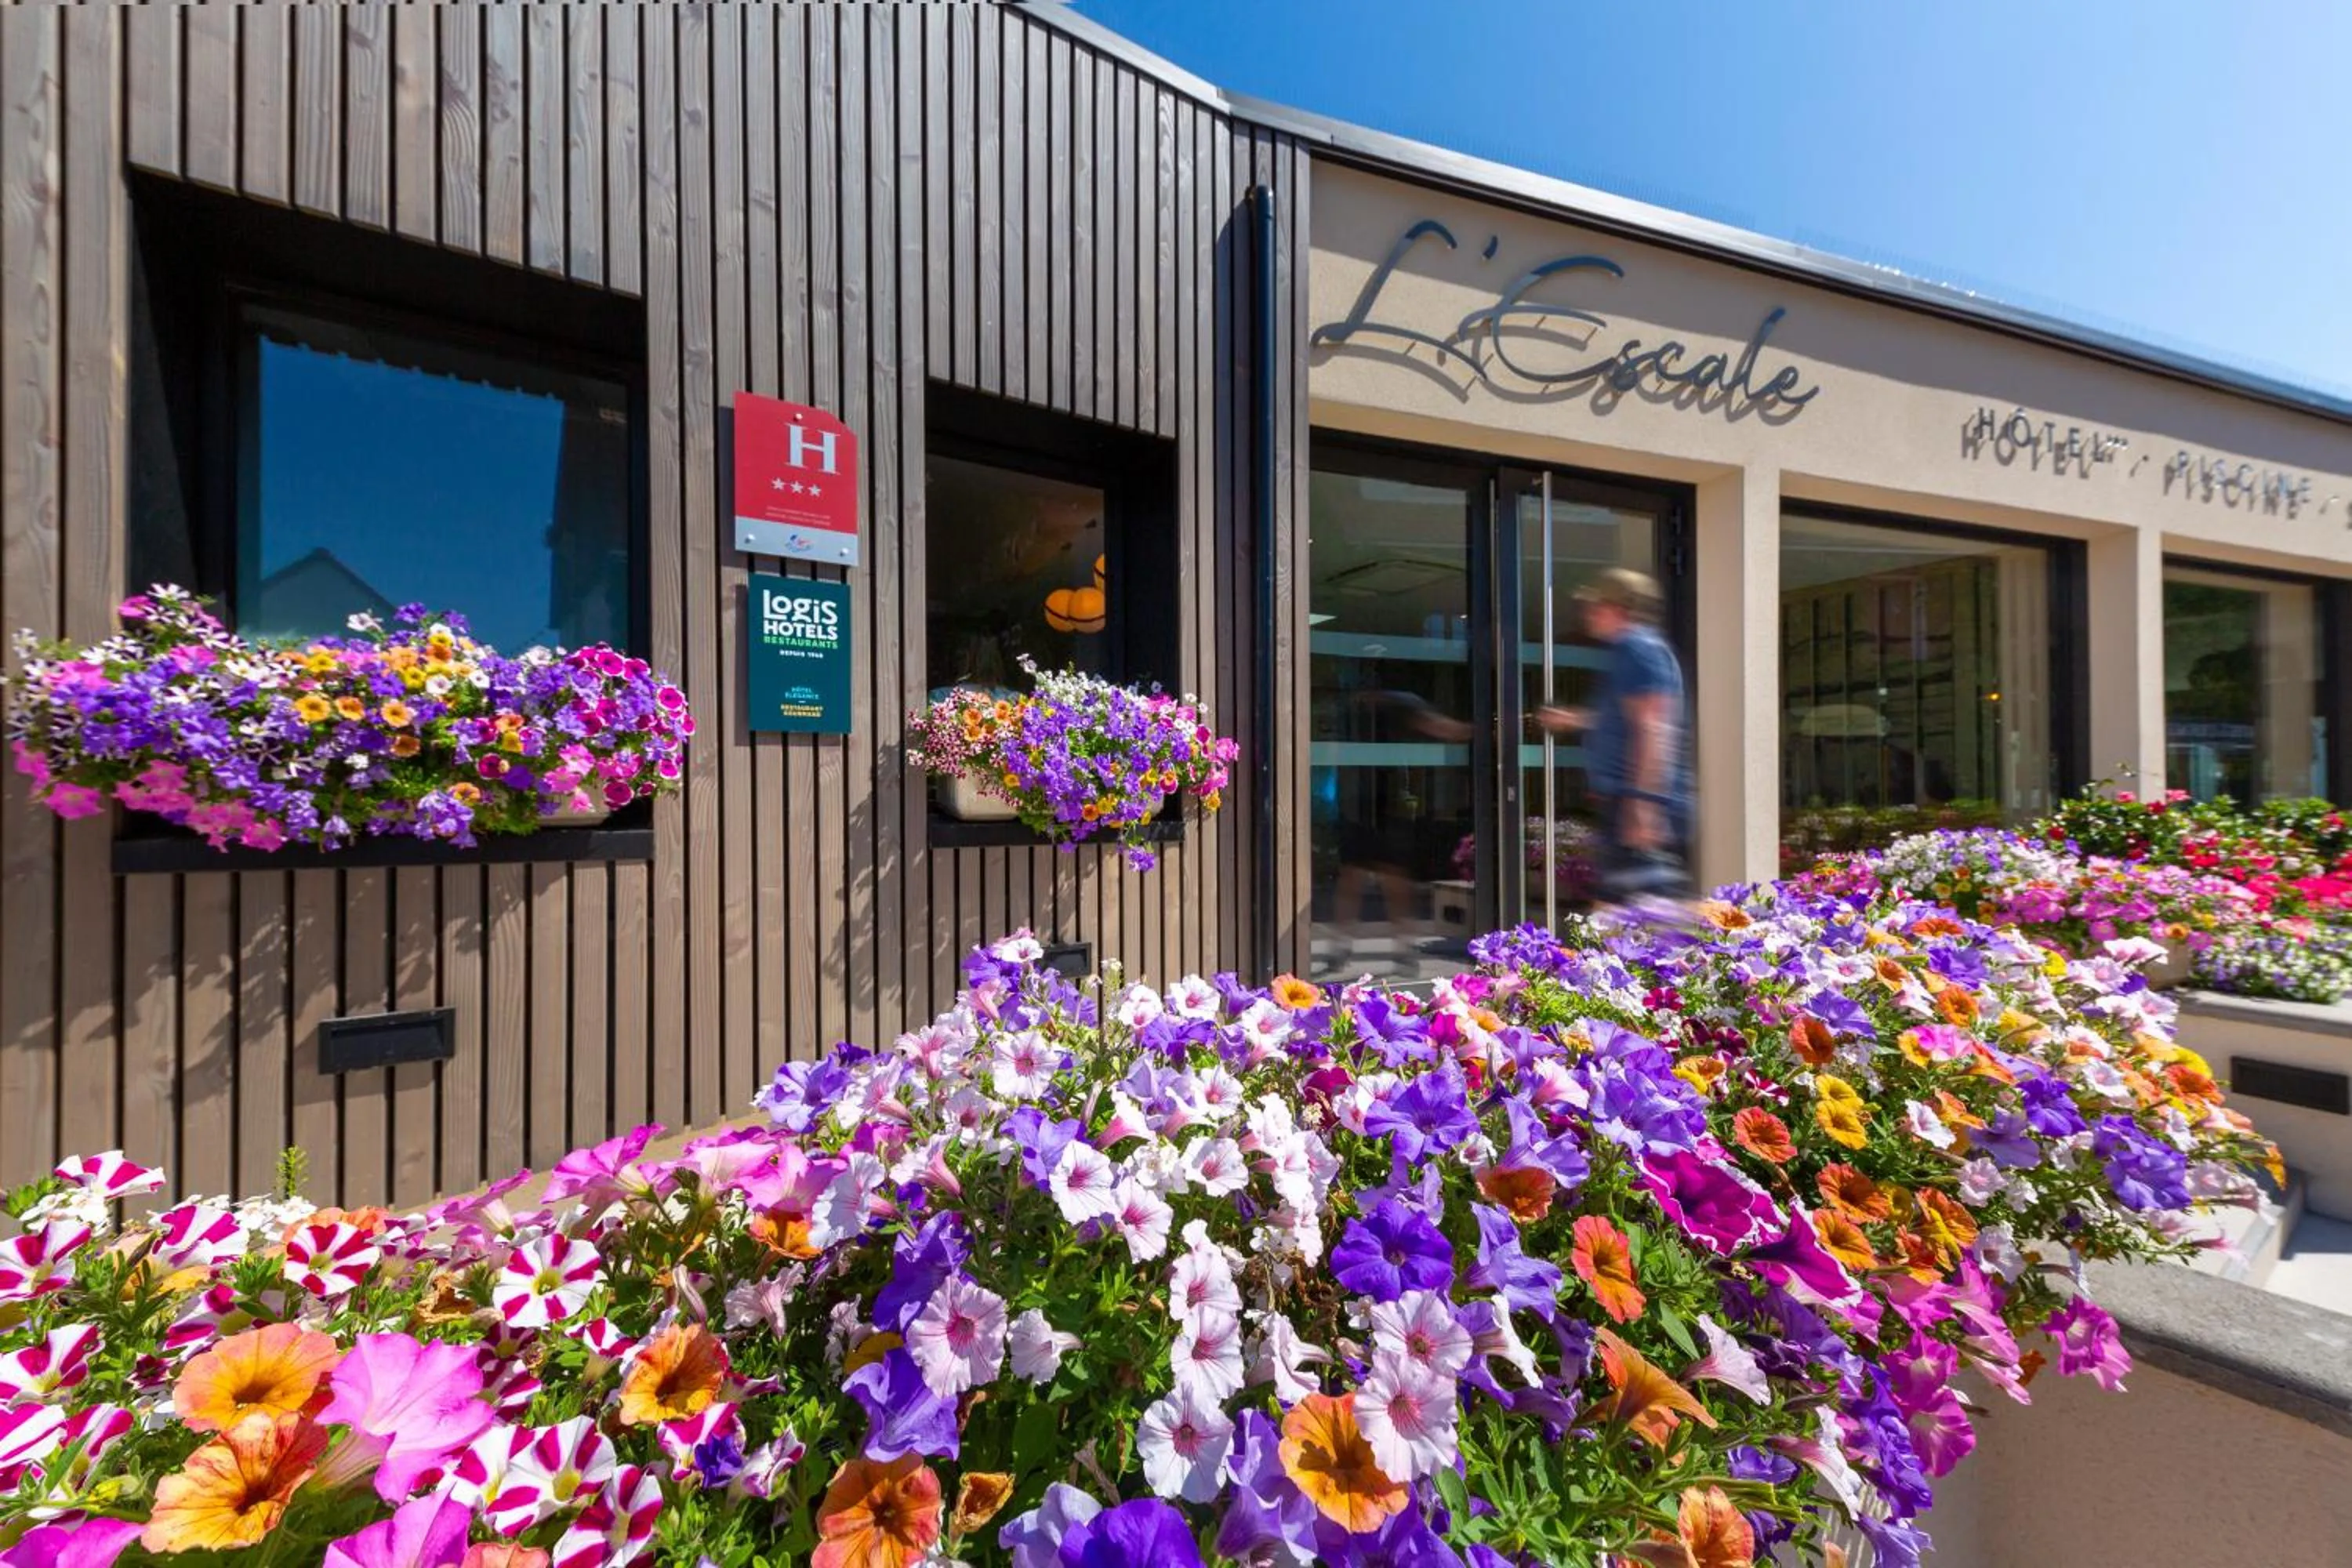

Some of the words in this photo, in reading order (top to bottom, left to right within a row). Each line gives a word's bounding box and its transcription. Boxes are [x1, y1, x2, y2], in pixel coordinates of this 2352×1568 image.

[1310, 220, 1820, 405] L'Escale
[785, 422, 840, 475] H
[763, 620, 838, 641] HOTELS
[763, 636, 838, 649] RESTAURANTS
